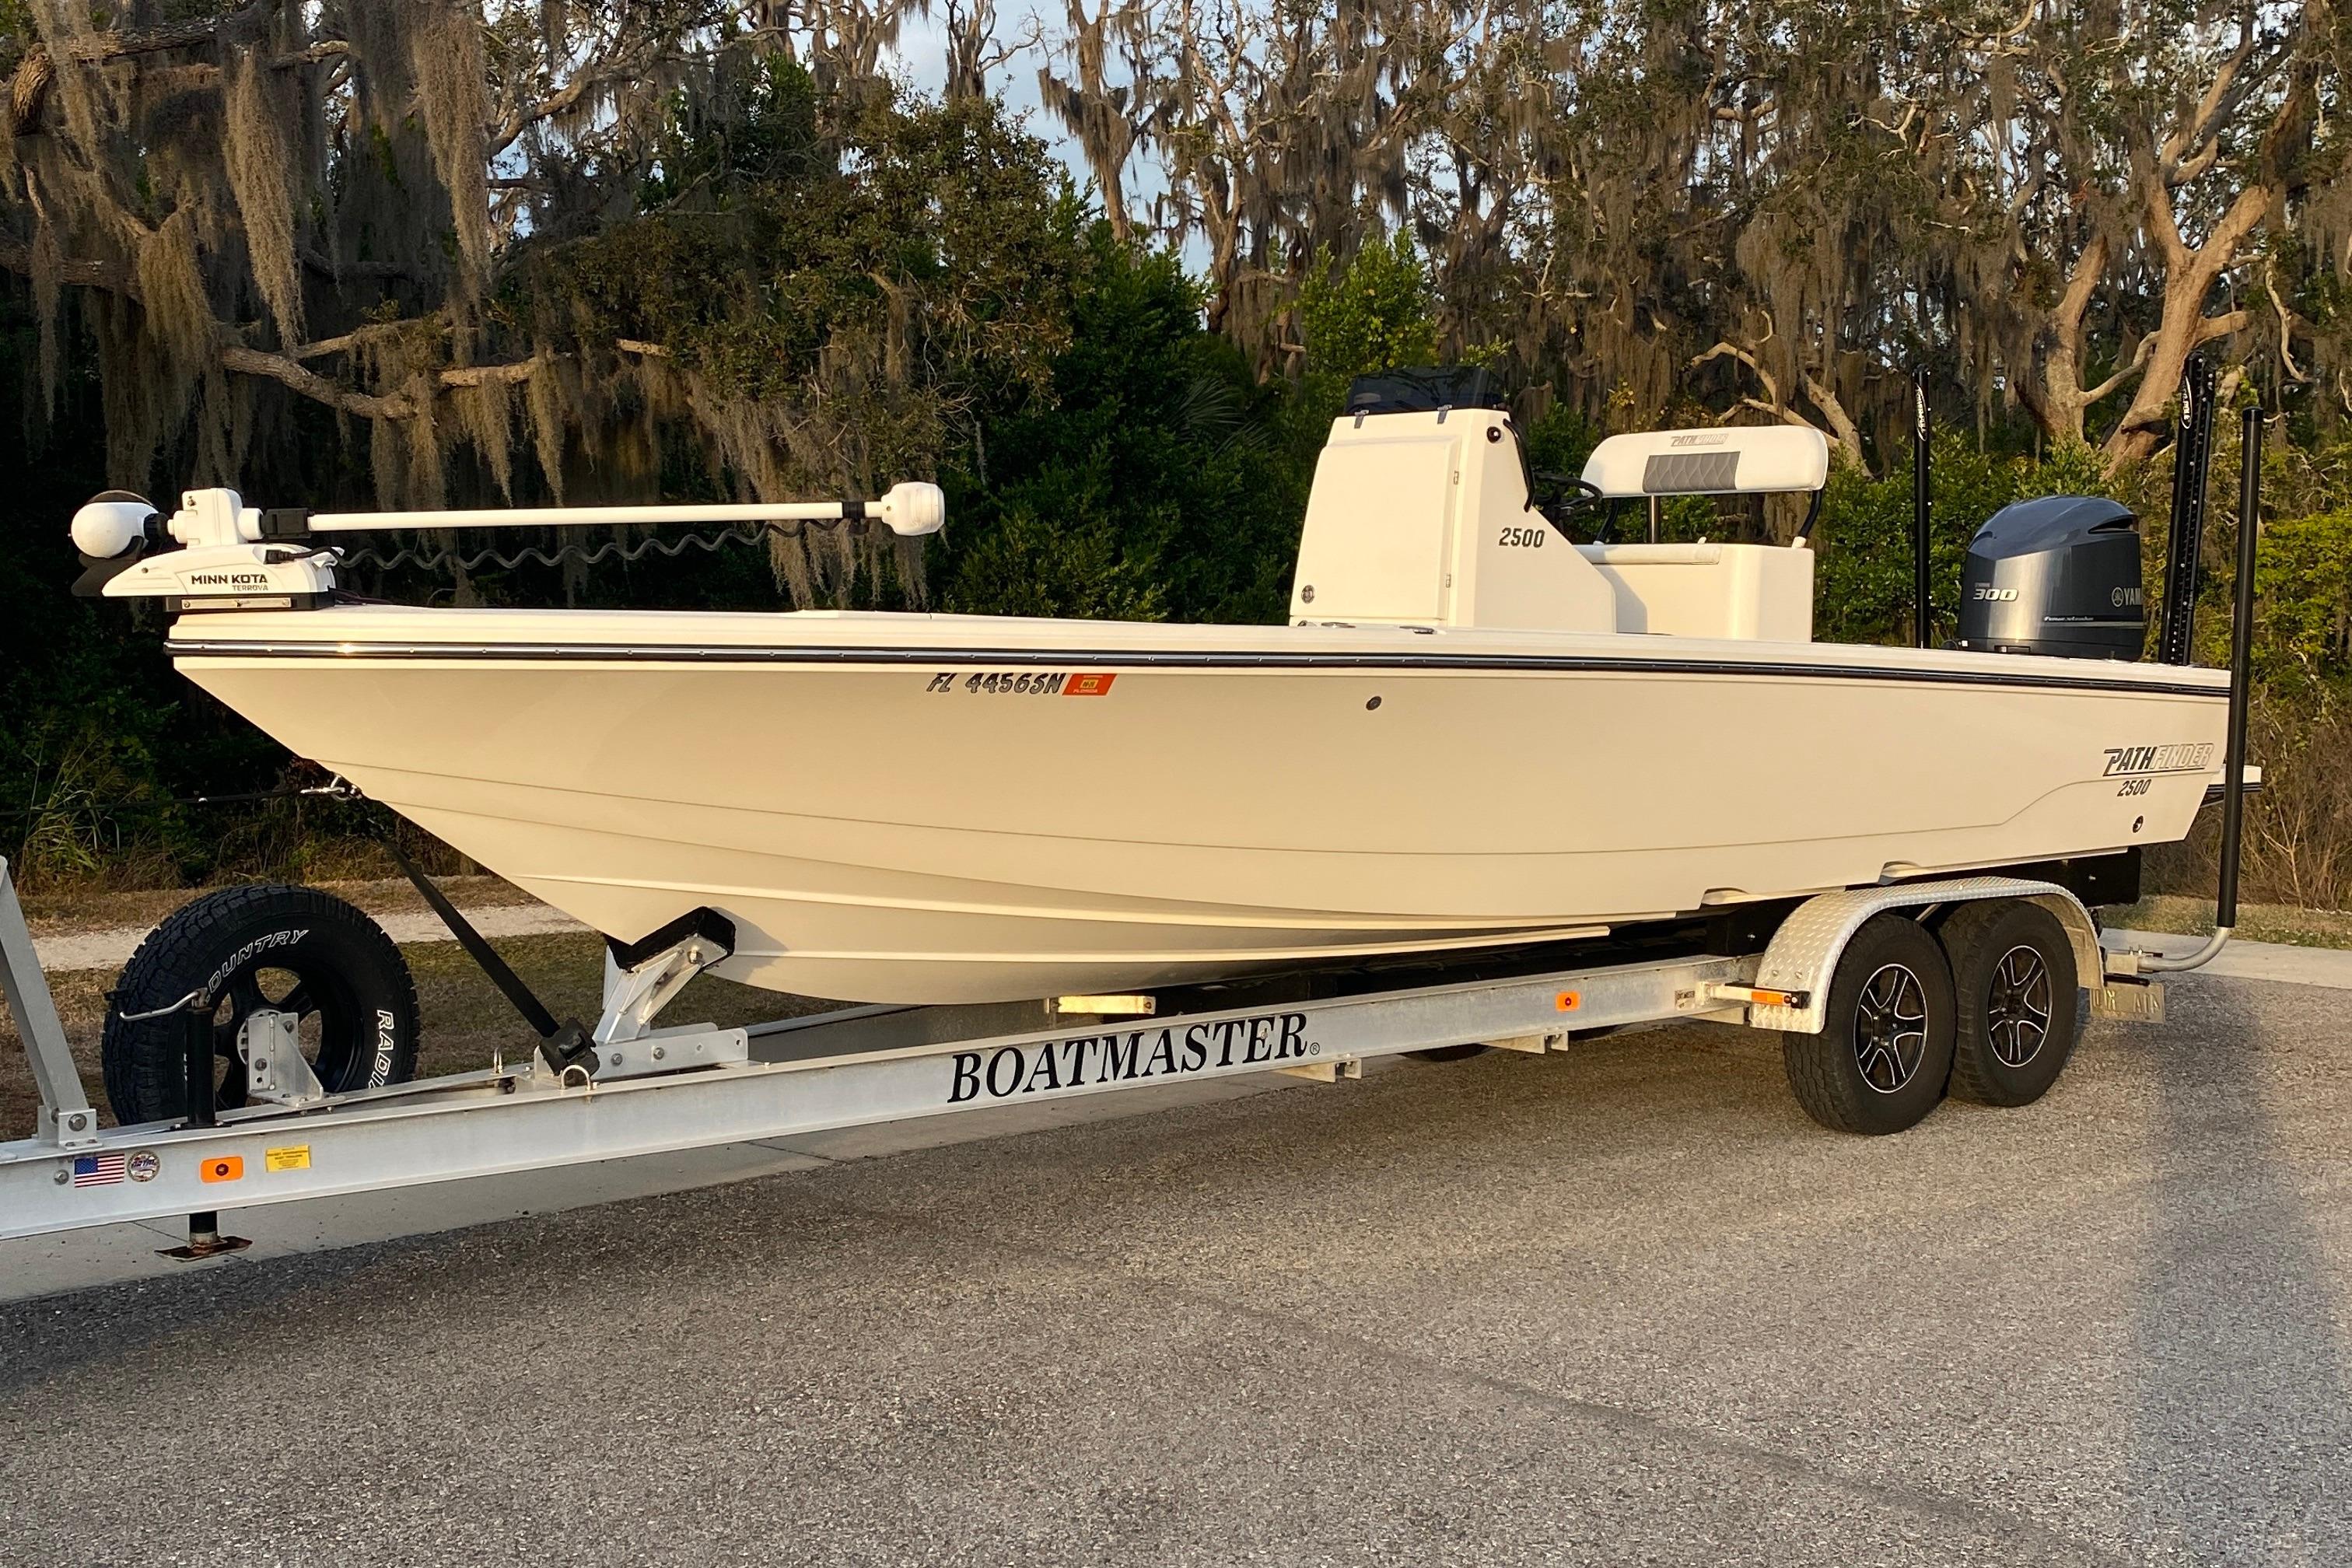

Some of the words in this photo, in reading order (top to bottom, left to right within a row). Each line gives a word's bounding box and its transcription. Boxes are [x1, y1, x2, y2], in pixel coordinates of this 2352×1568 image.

[1499, 527, 1545, 548] 2500
[191, 575, 228, 584] MINN
[232, 574, 268, 583] KOTA
[1972, 589, 2018, 601] 300
[926, 673, 957, 692] FL
[965, 673, 1066, 695] 4456SN
[2102, 743, 2214, 777] PATHFINDER
[2116, 779, 2152, 796] 2500
[205, 929, 309, 1003] OUNTRY
